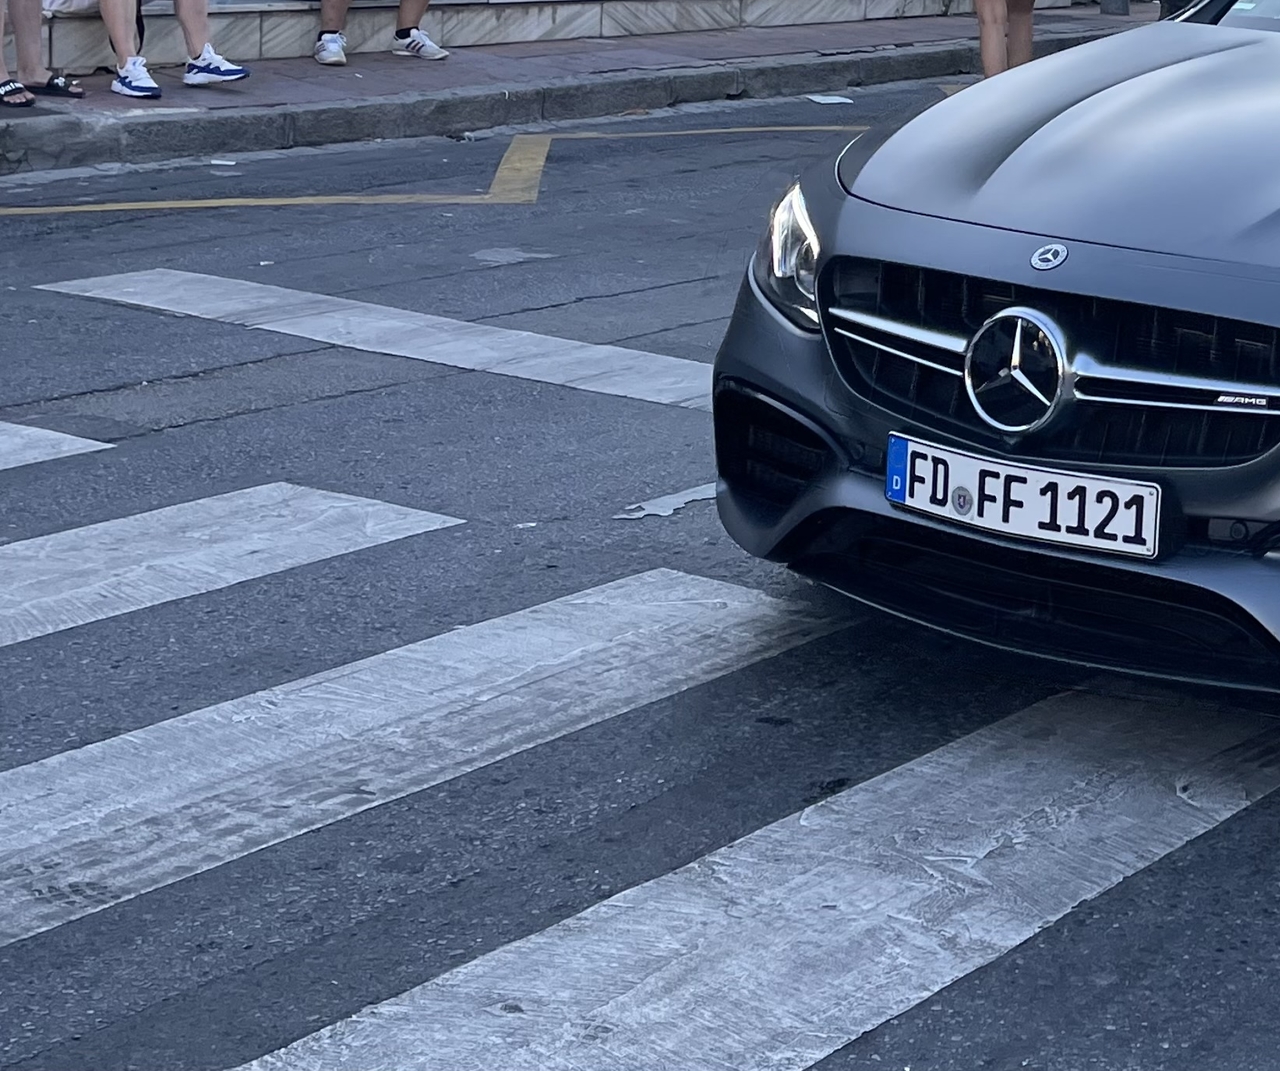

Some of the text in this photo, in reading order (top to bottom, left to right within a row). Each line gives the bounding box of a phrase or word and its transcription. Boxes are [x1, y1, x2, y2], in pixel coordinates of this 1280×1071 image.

[1232, 396, 1267, 406] AMG
[892, 474, 902, 490] D
[908, 449, 1148, 547] FD FF 1121
